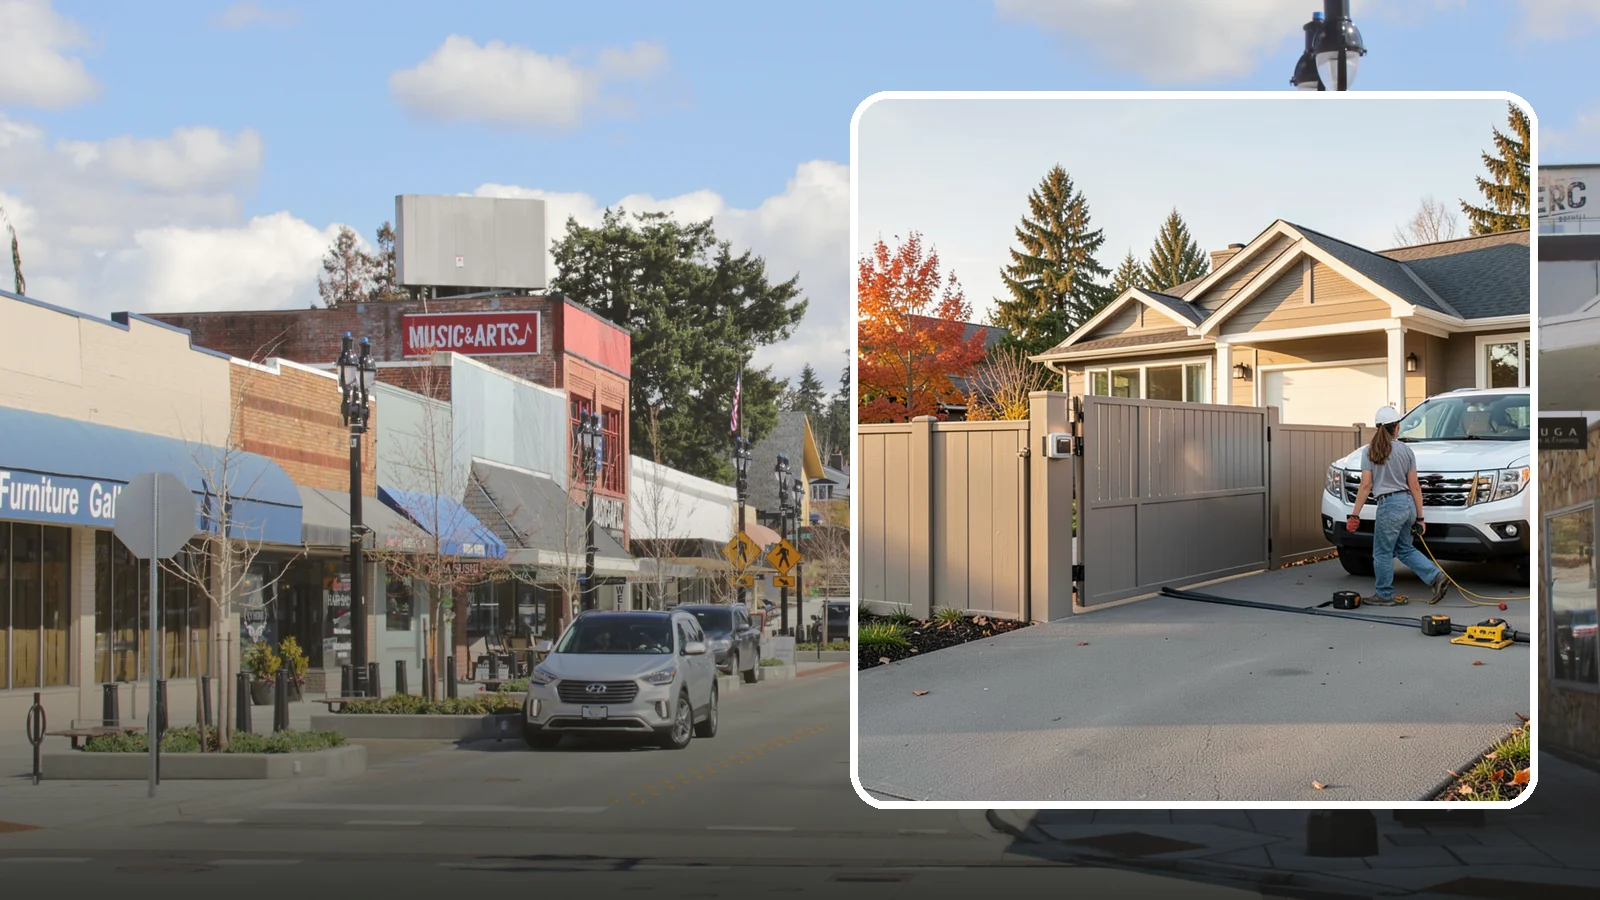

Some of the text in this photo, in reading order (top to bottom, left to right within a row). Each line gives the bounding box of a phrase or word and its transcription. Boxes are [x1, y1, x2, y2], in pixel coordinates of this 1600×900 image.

[409, 323, 519, 349] MUSIC&ARTS
[1541, 428, 1577, 437] UGA
[0, 472, 121, 519] Furniture Gal
[453, 563, 480, 574] SUSHI
